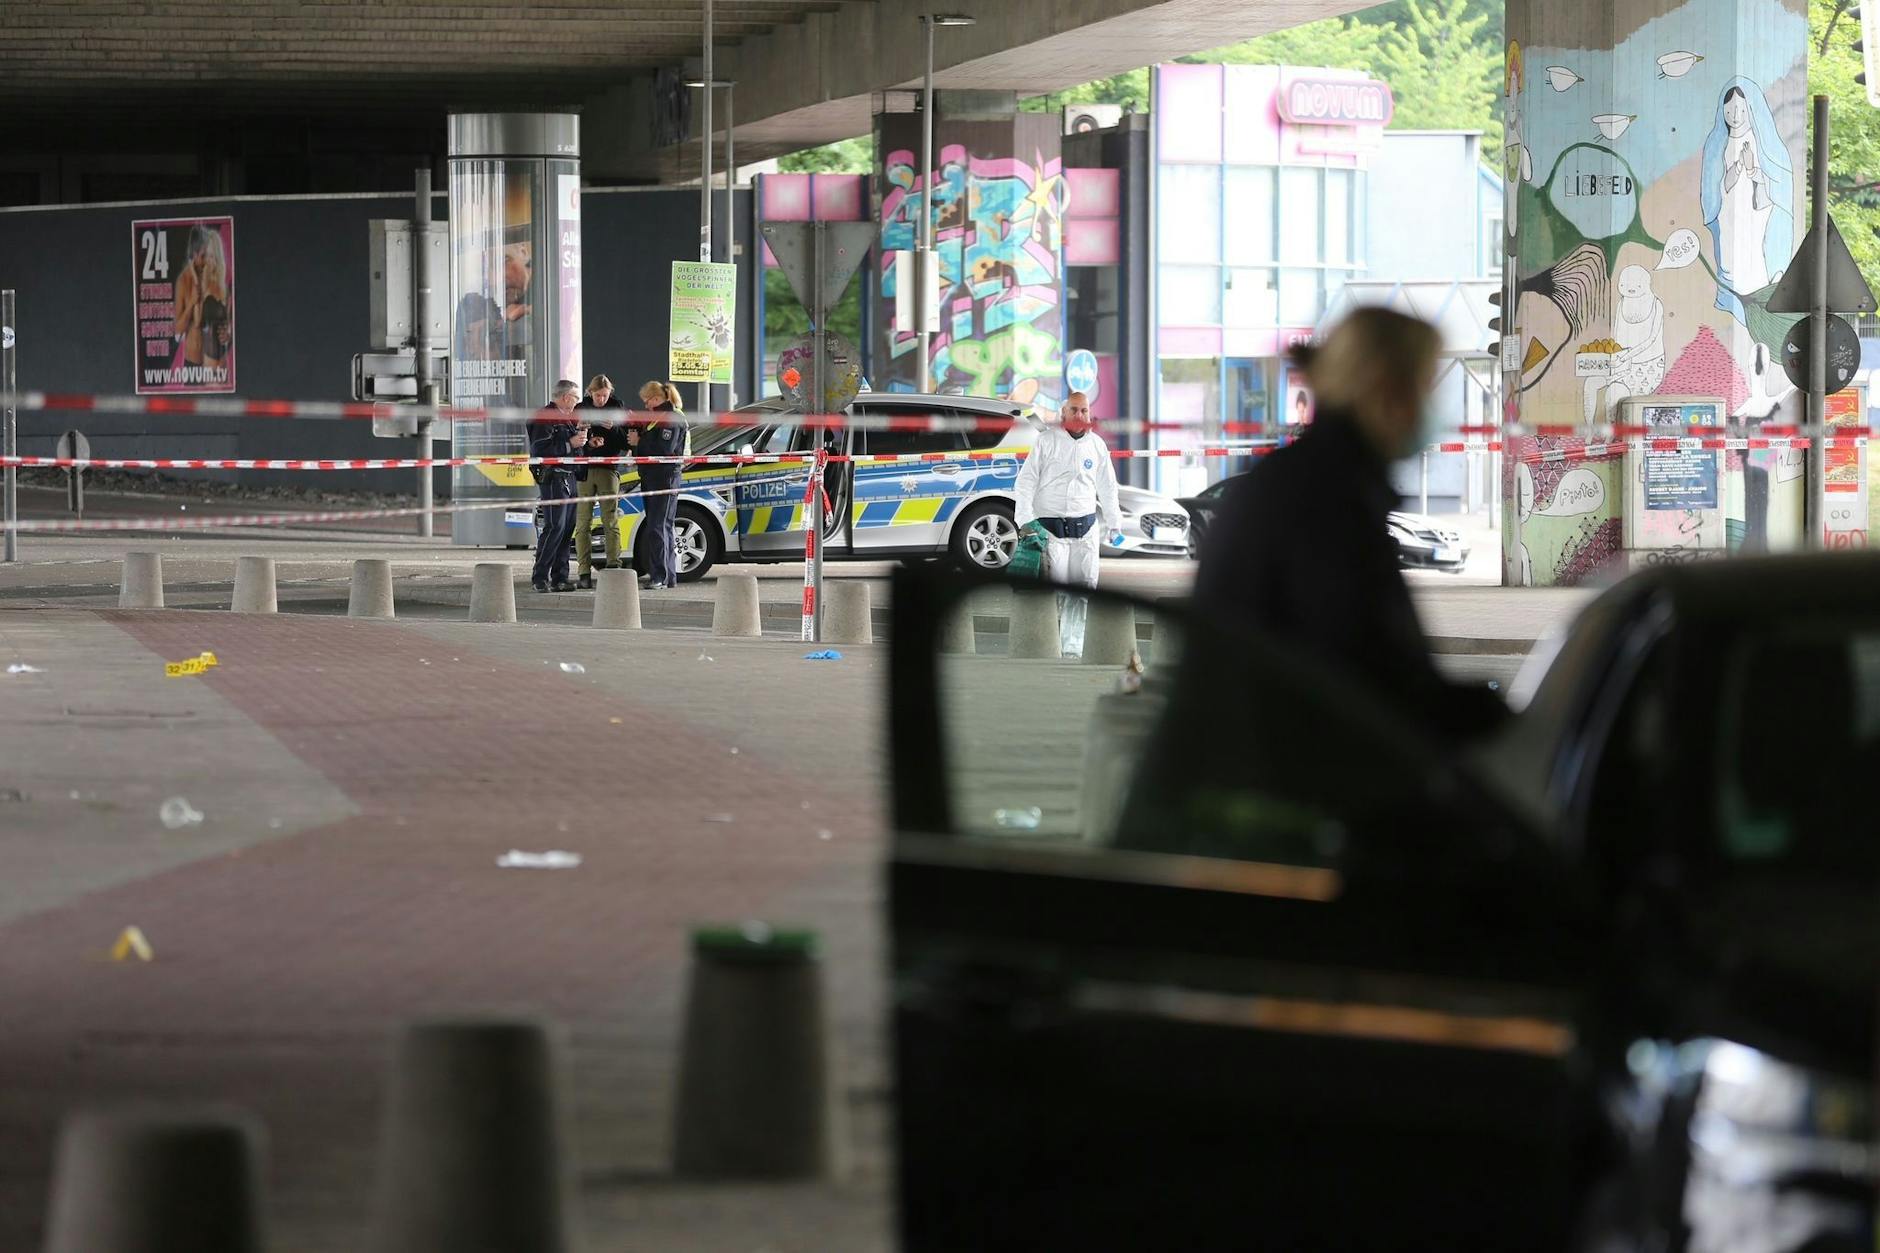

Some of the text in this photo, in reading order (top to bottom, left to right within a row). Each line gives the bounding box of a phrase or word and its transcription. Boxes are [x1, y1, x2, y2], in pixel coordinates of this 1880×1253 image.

[141, 230, 169, 280] 24
[144, 366, 228, 384] www.novum.tv
[672, 368, 709, 377] Sonntag
[742, 482, 787, 500] POLIZEI
[167, 665, 180, 674] 32
